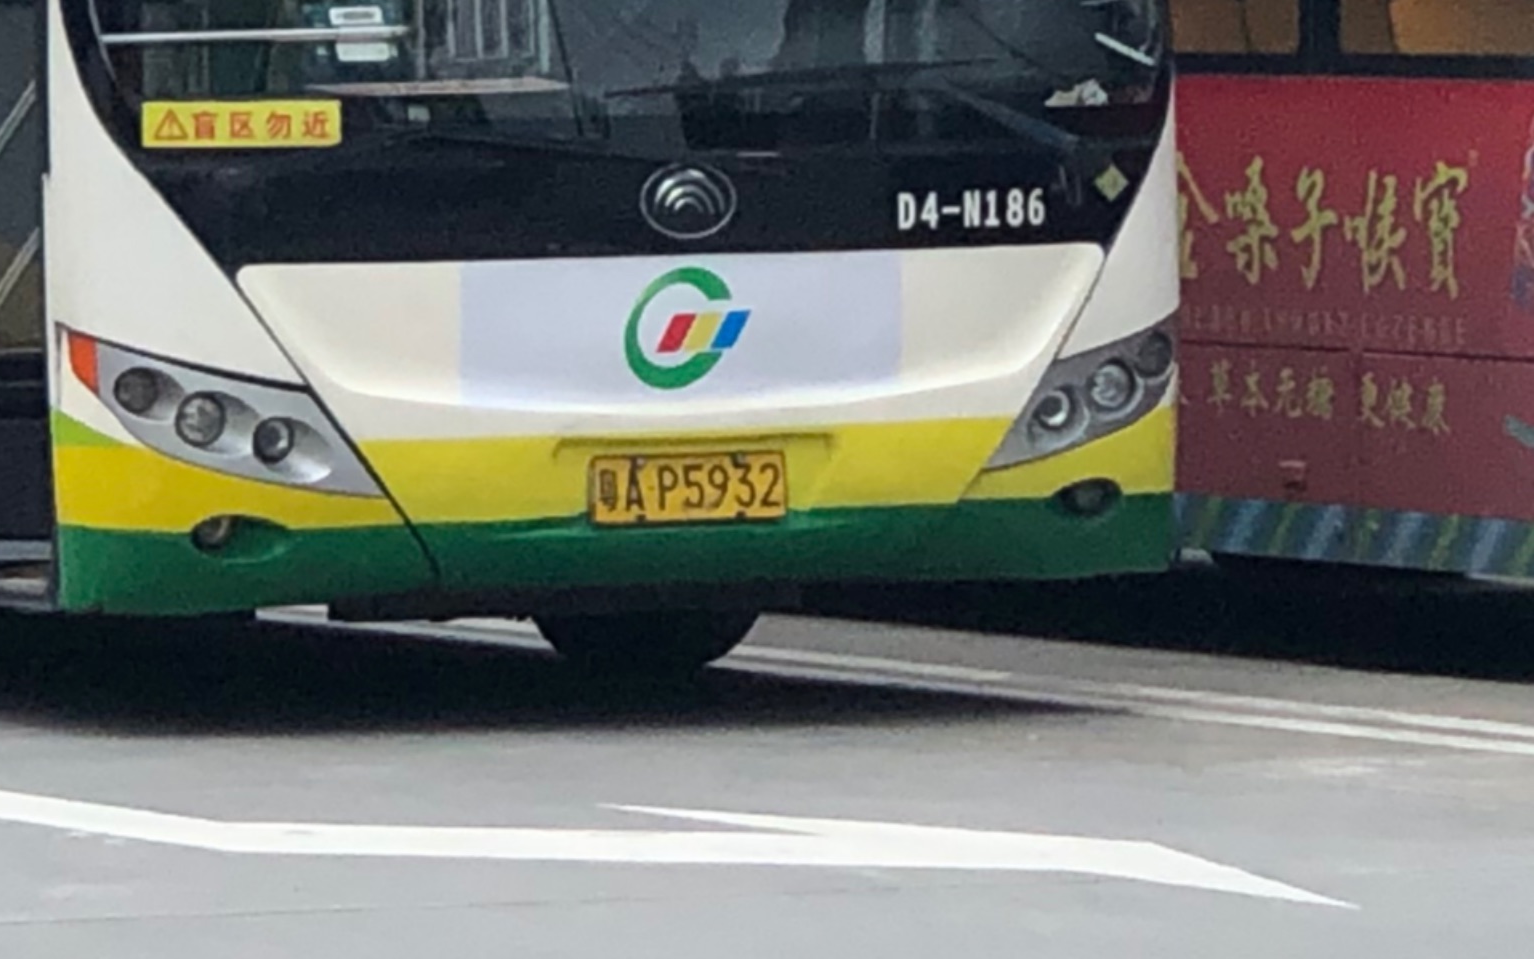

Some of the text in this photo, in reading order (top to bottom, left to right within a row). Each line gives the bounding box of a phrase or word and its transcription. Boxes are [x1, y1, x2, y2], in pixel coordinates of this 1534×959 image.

[191, 111, 330, 140] 盲区勿近
[897, 187, 1046, 230] D4-N186
